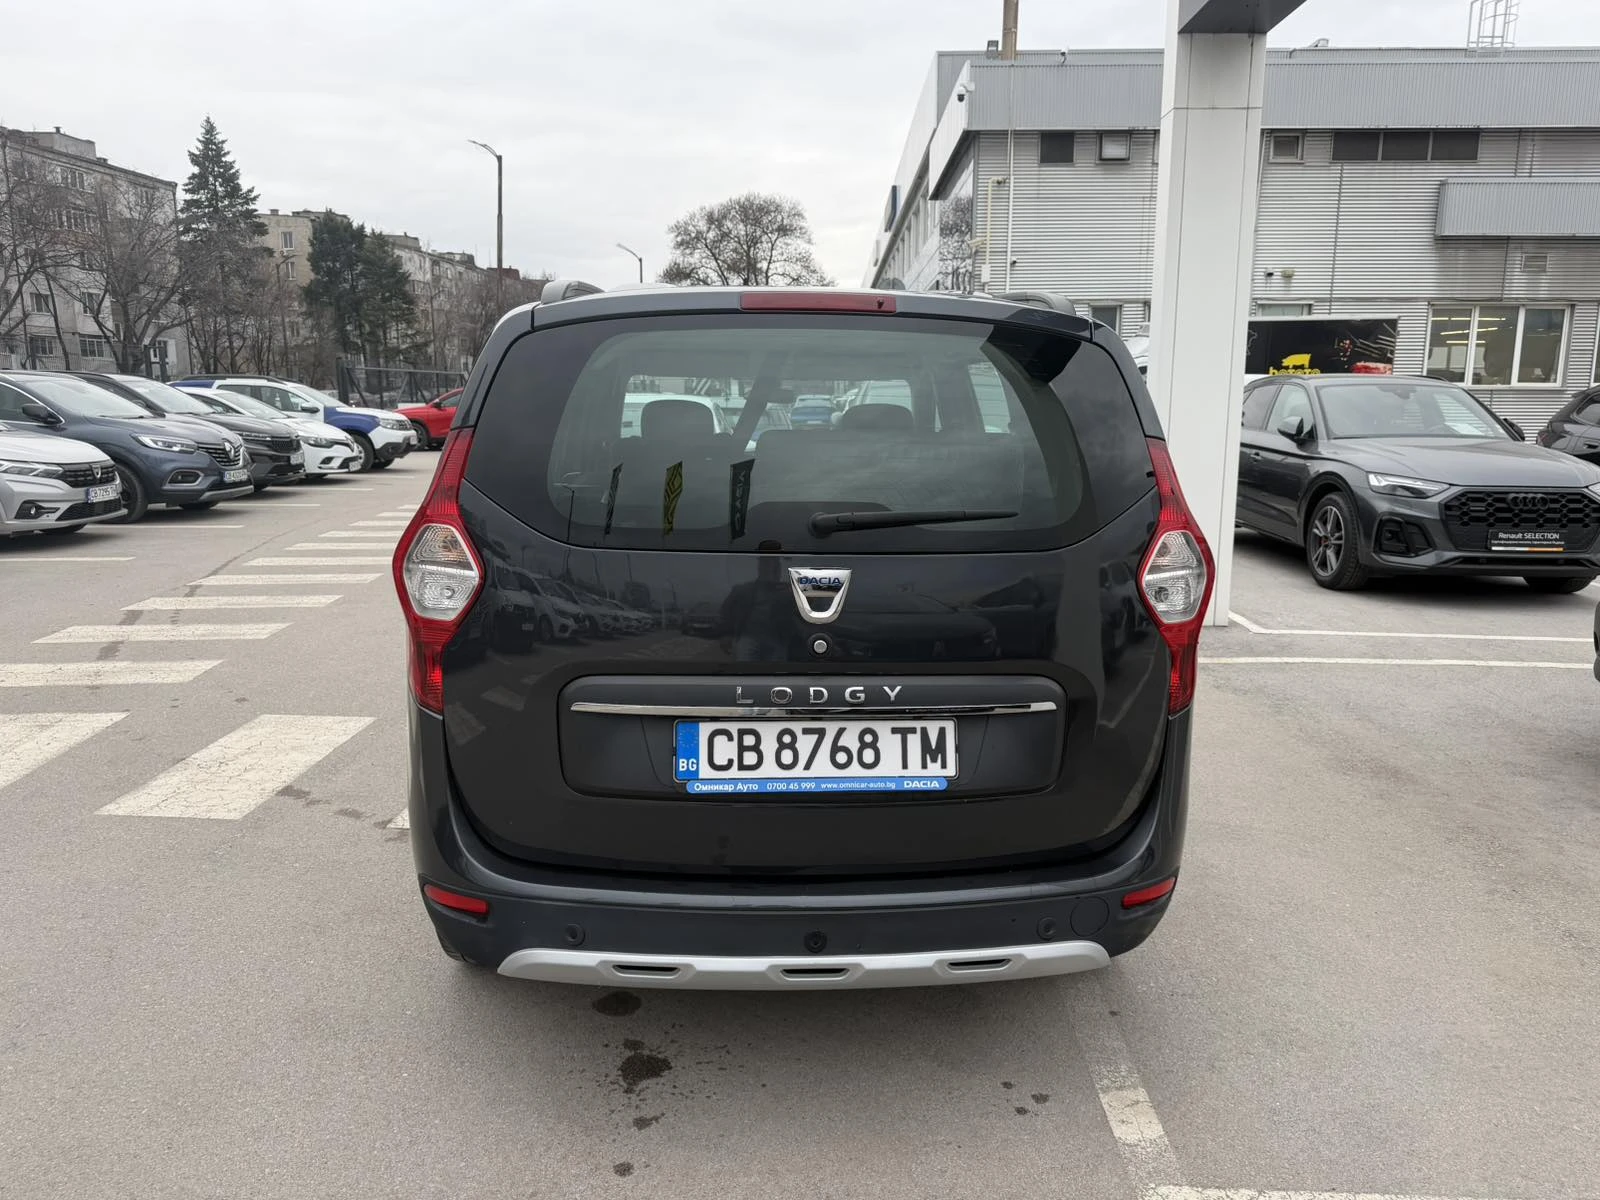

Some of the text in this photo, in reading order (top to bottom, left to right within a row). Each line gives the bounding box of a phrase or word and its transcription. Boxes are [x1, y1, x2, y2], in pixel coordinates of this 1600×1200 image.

[799, 577, 842, 585] DACIA
[736, 686, 902, 704] LODGY
[707, 726, 948, 771] CB 8768 TM
[679, 758, 697, 772] BG
[694, 780, 940, 792] Омникар Ауто 0700 45 999 www.omnicar-auto.bg DACIA
